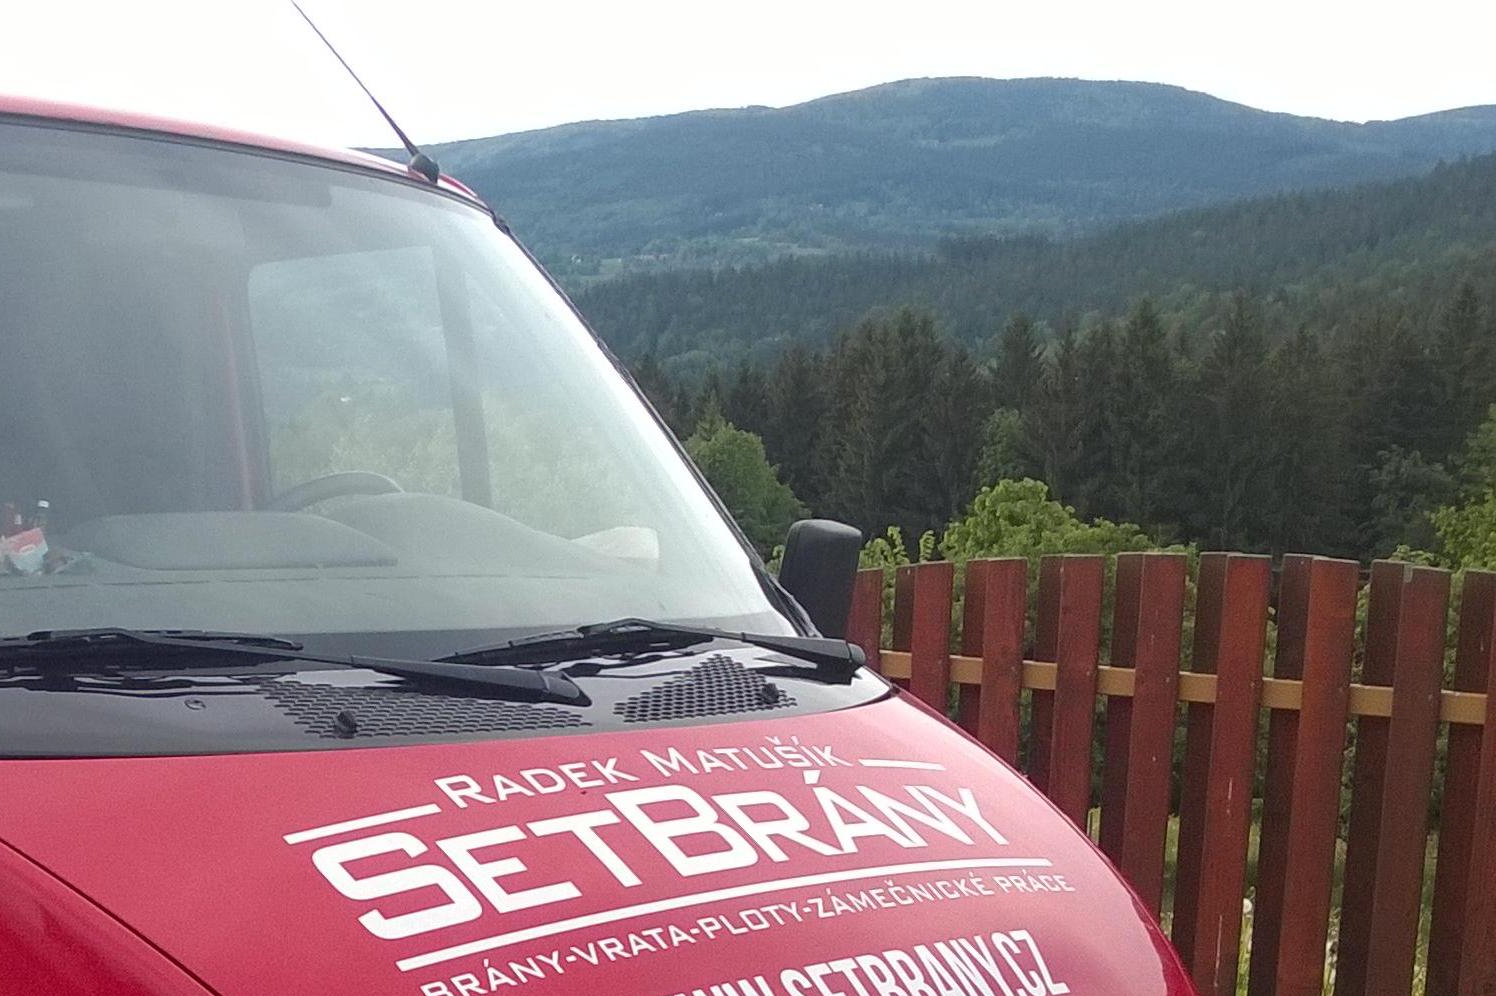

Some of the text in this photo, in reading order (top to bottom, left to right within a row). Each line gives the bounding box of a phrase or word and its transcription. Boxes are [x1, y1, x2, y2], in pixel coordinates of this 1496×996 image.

[433, 734, 854, 809] RADEK MATUŠÍK
[311, 769, 1010, 940] SETBRÁNY
[997, 868, 1076, 894] PRÁCE
